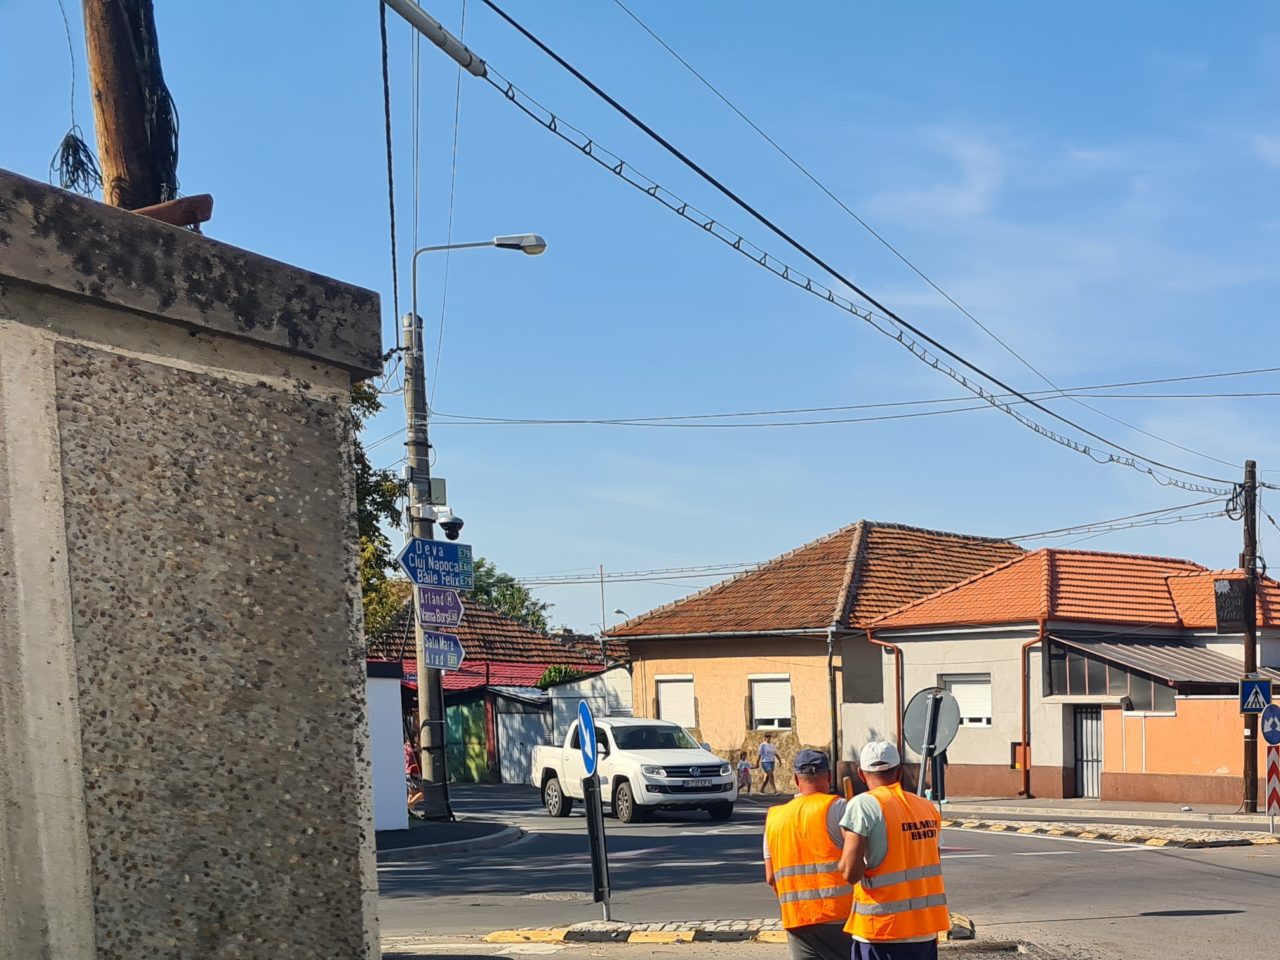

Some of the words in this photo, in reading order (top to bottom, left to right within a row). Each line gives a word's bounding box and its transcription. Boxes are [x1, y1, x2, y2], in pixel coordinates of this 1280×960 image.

[416, 540, 444, 557] Deva
[409, 553, 426, 571] Cluj
[428, 556, 459, 573] Napoca
[441, 572, 459, 586] Felix
[421, 608, 436, 622] Vama
[439, 636, 454, 652] Mare
[426, 650, 444, 665] Arad
